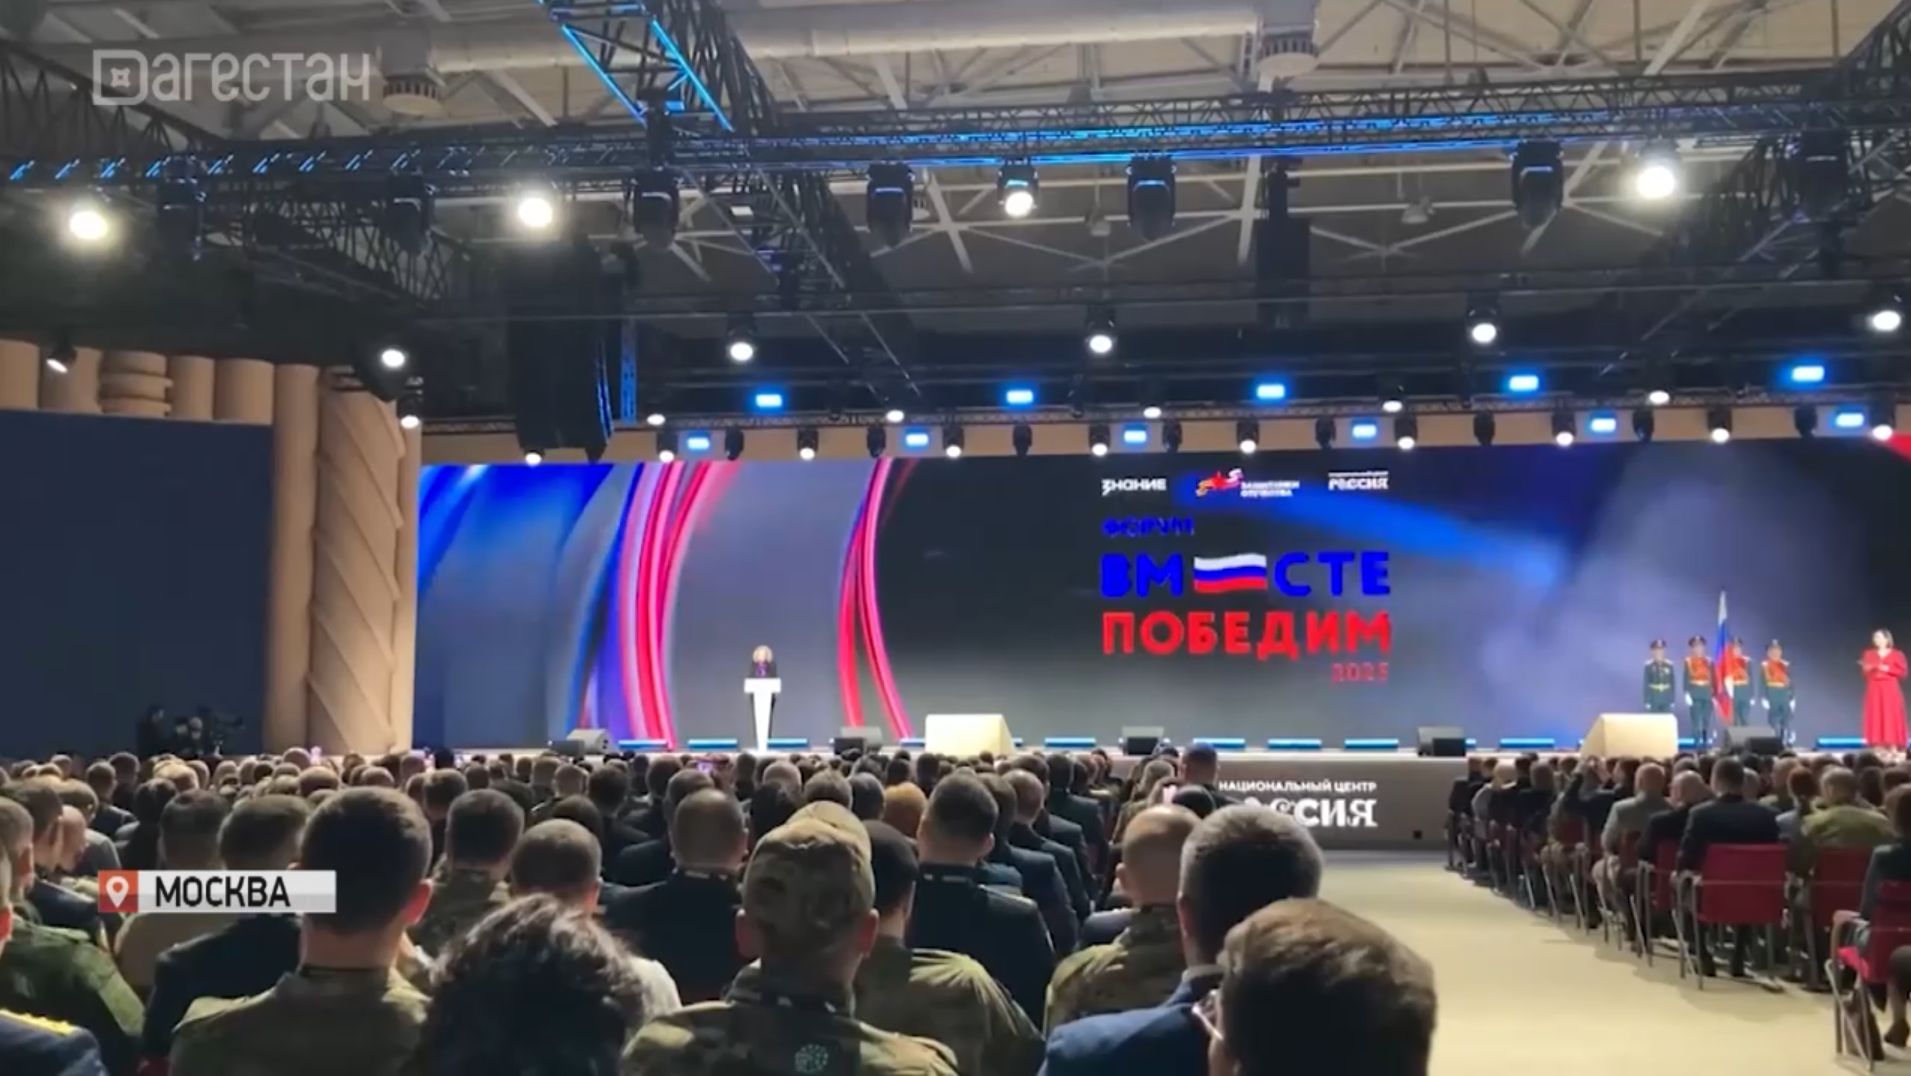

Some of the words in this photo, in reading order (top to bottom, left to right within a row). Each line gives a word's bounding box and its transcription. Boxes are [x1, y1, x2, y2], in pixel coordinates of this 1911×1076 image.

[1100, 550, 1391, 598] ВМСТЕ
[1102, 610, 1392, 661] ПОБЕДИМ
[1218, 778, 1332, 792] НАЦИОНАЛЬНЫЙ
[1333, 781, 1378, 793] ЦЕНТР
